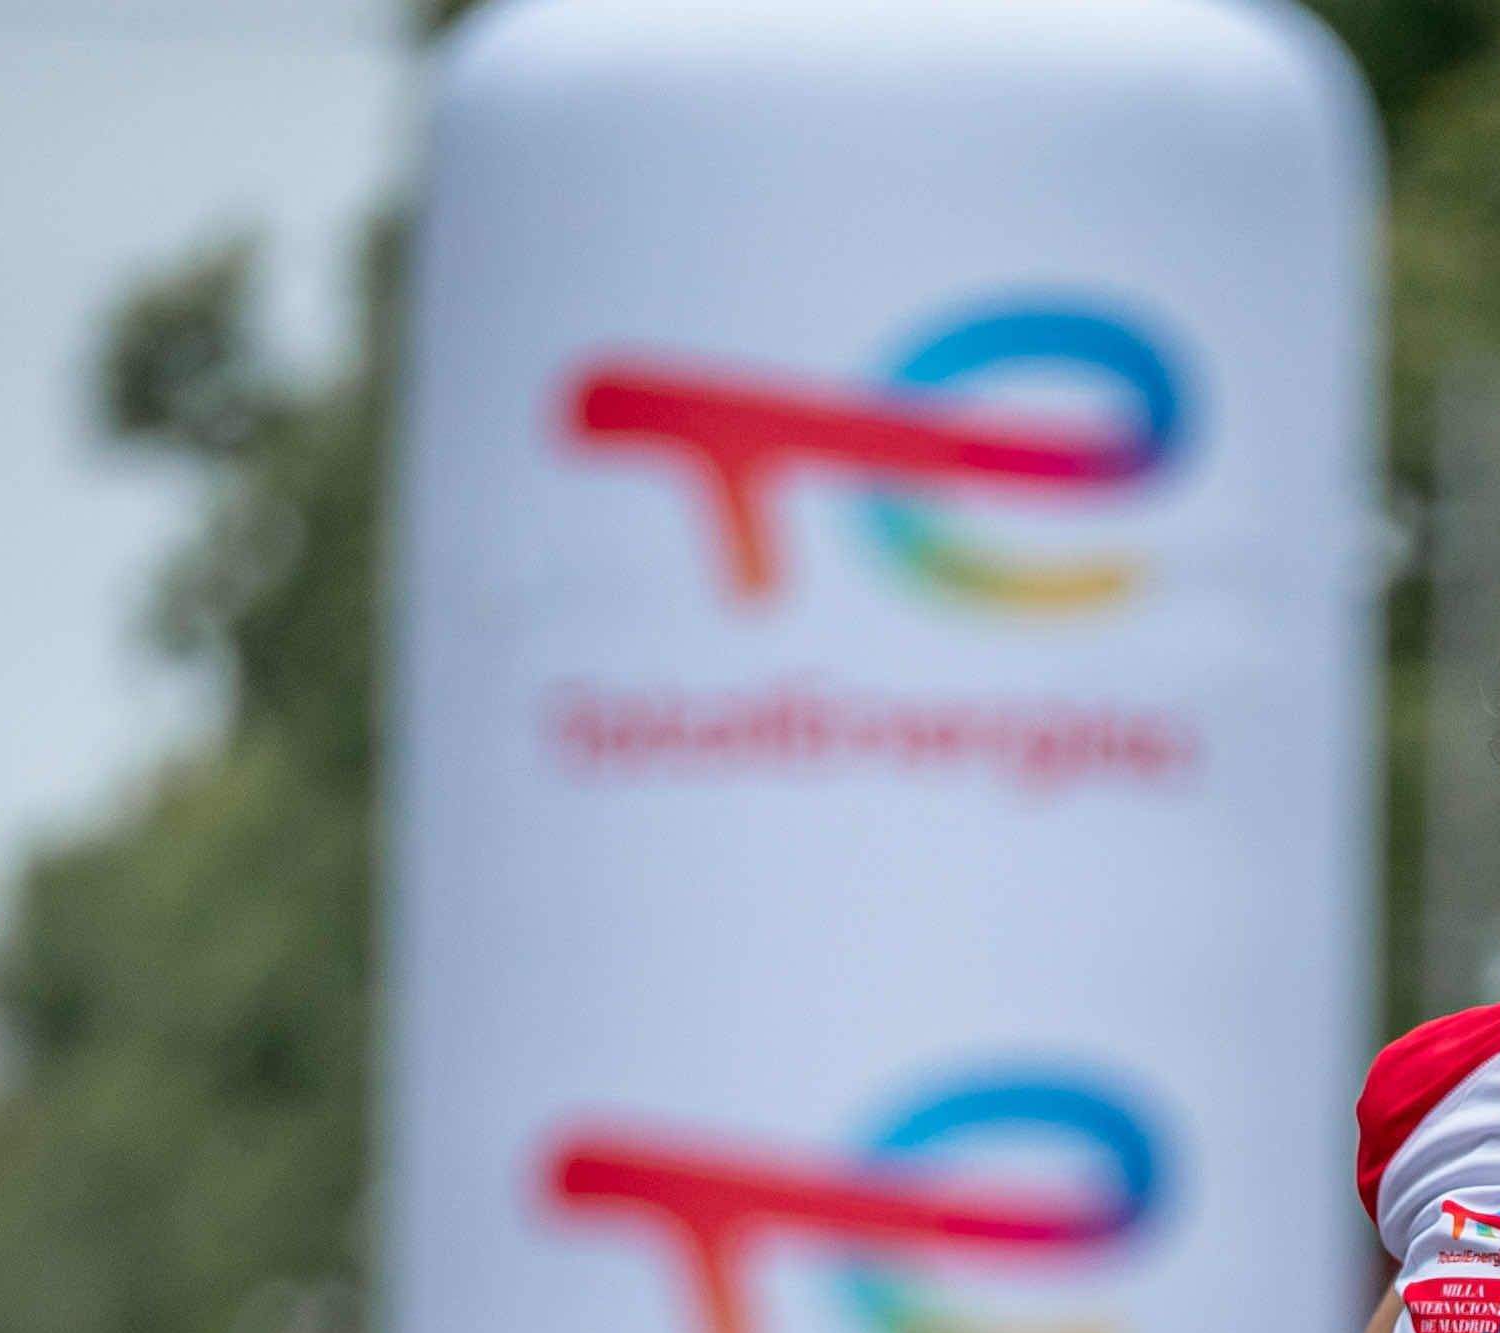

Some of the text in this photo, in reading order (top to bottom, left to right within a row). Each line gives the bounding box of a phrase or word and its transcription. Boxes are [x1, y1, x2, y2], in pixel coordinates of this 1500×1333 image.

[1442, 1284, 1485, 1298] MILLA
[1421, 1319, 1498, 1333] DE MADRID
